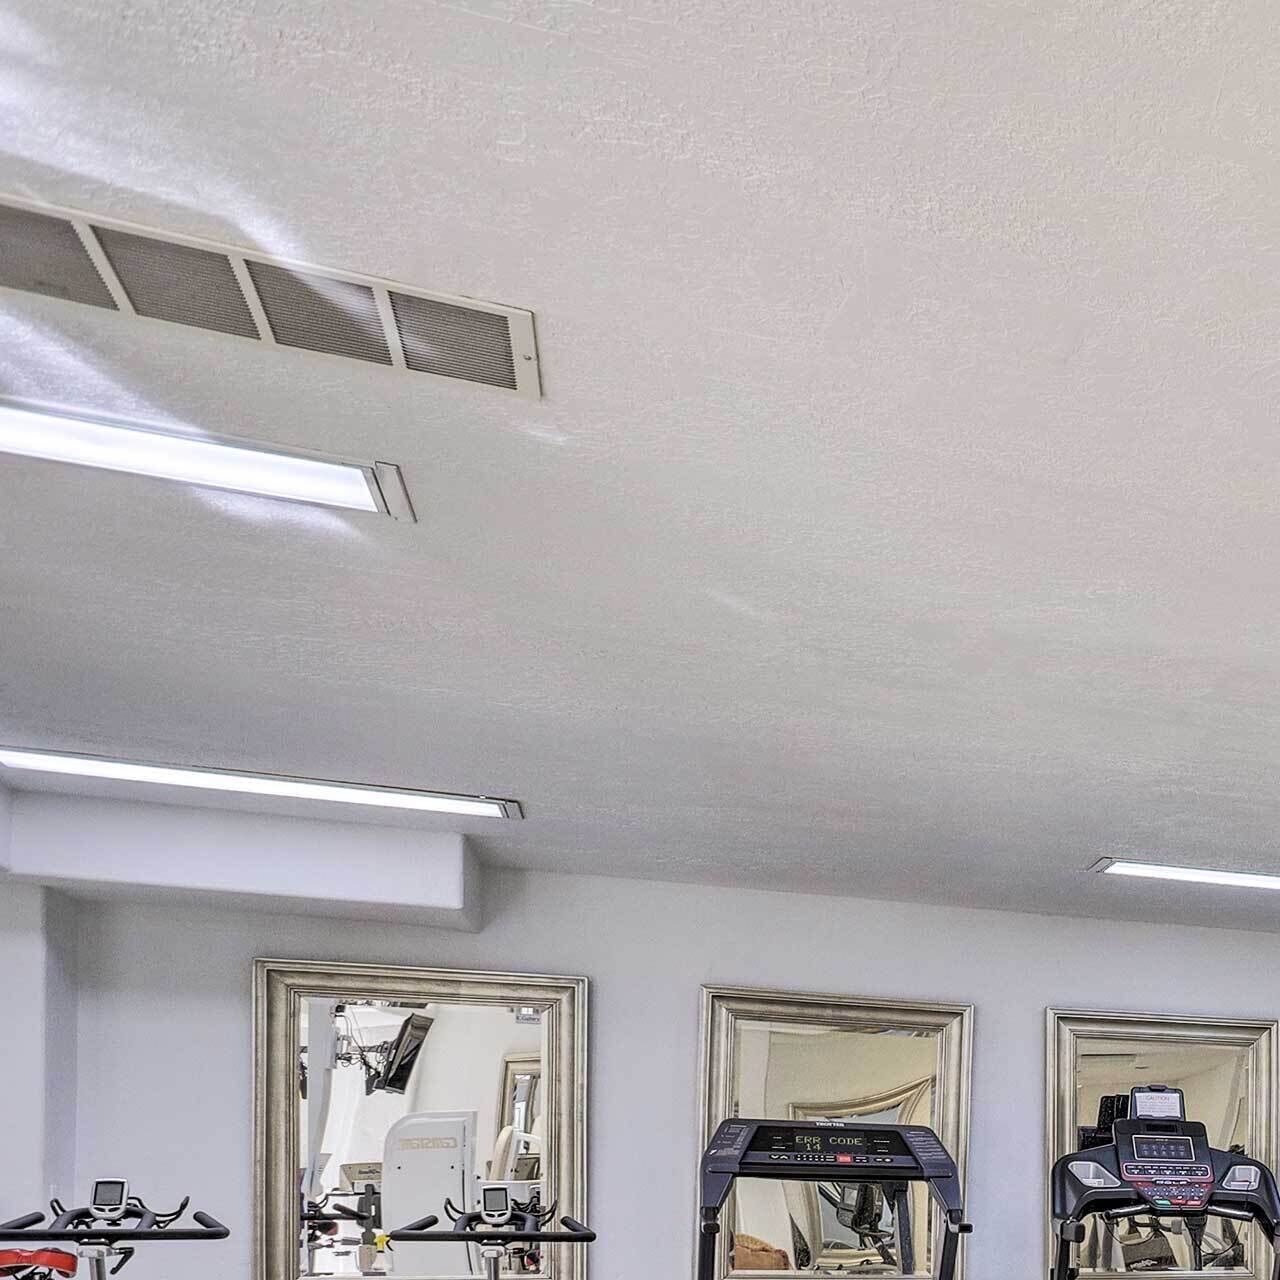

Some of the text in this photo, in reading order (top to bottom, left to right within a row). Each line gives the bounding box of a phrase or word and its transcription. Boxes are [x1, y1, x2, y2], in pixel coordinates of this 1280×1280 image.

[795, 1135, 863, 1146] ERR CODE
[806, 1143, 821, 1151] 14
